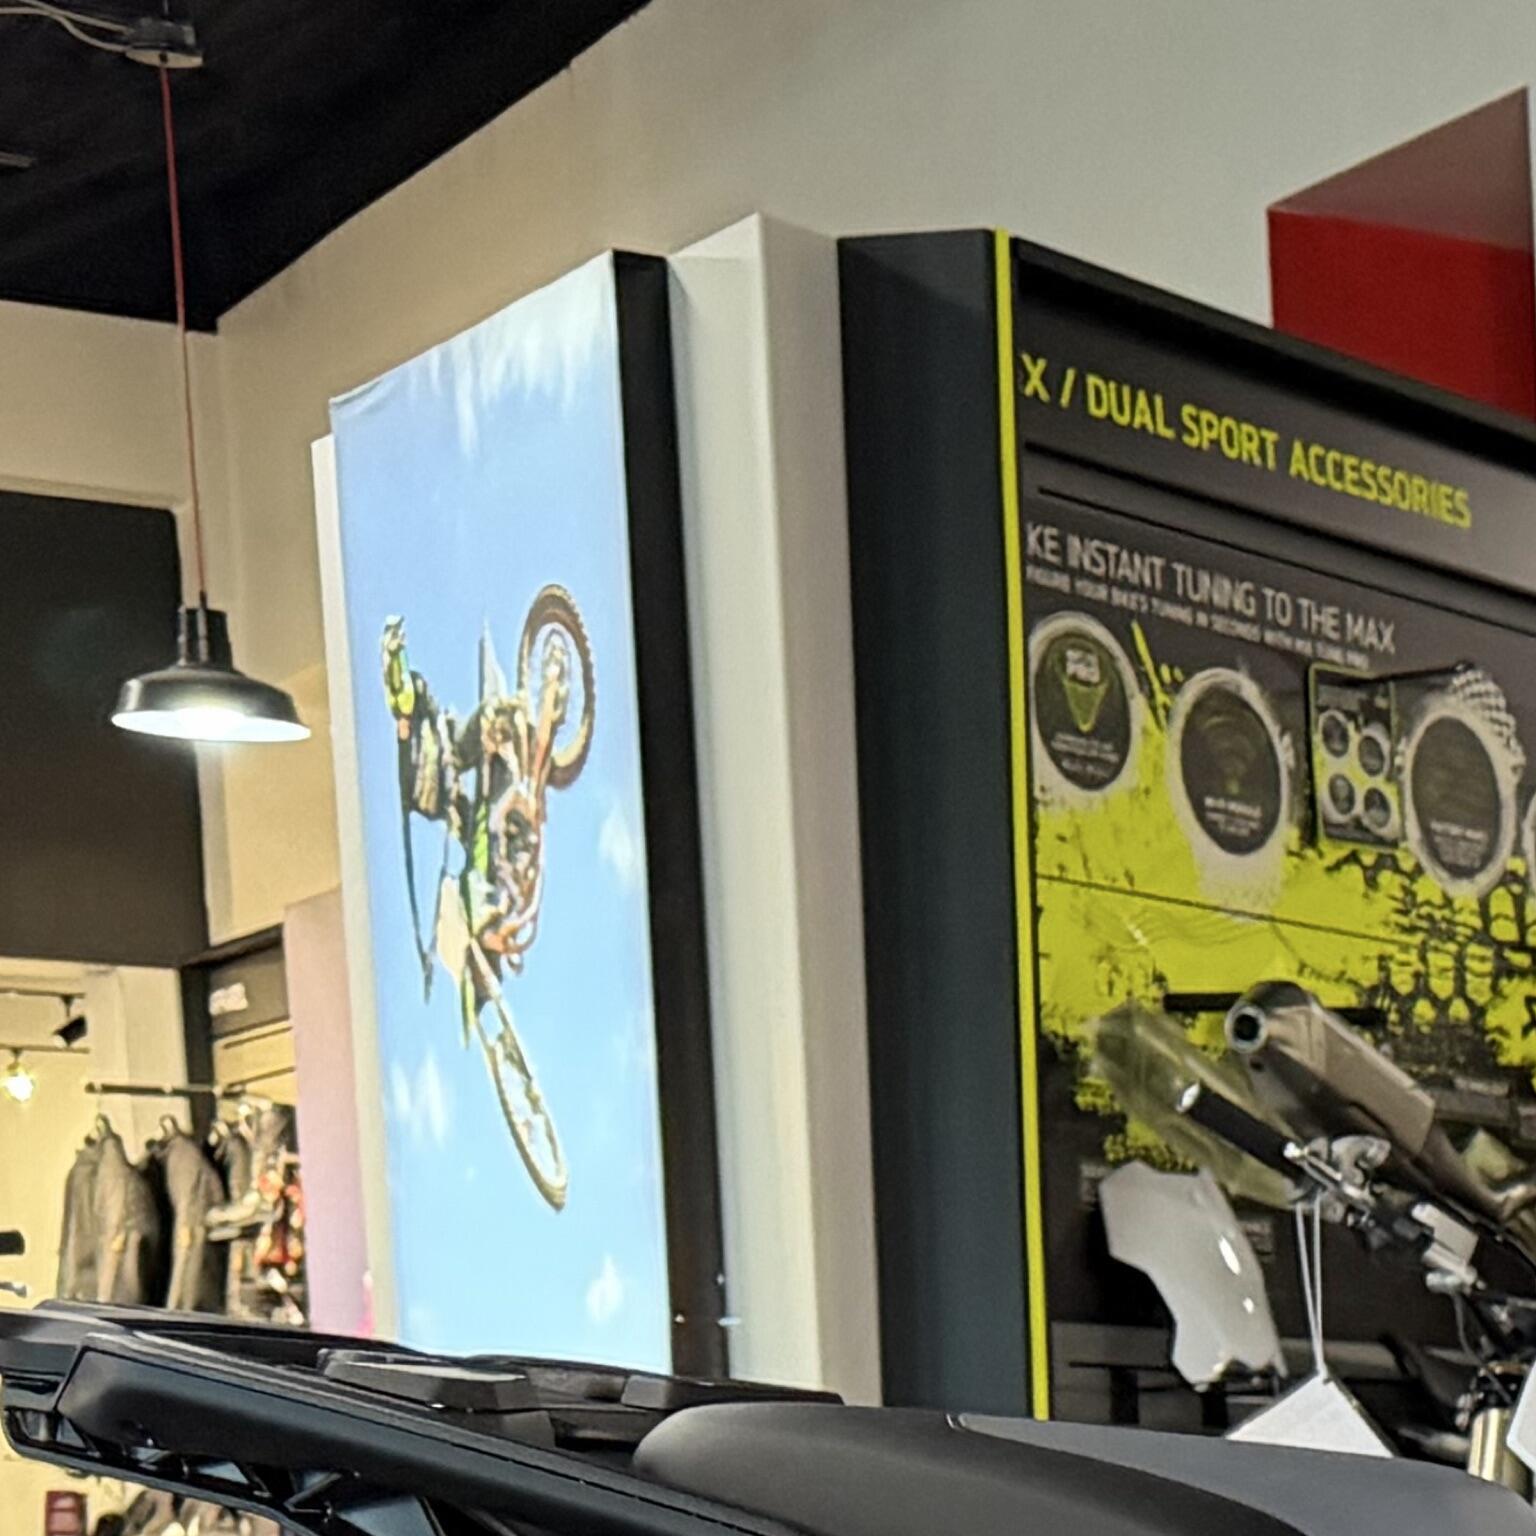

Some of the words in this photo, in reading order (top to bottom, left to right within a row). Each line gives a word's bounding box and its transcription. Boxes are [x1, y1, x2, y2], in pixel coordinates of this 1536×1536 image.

[1085, 374, 1175, 441] DUAL
[1181, 403, 1280, 472] SPORT
[1289, 438, 1471, 528] ACCESSORIES
[1066, 533, 1167, 591] INSTANT
[1171, 561, 1256, 617] TUNING
[1261, 588, 1292, 627] TO
[1297, 596, 1340, 640] THE
[1346, 612, 1395, 655] MAX
